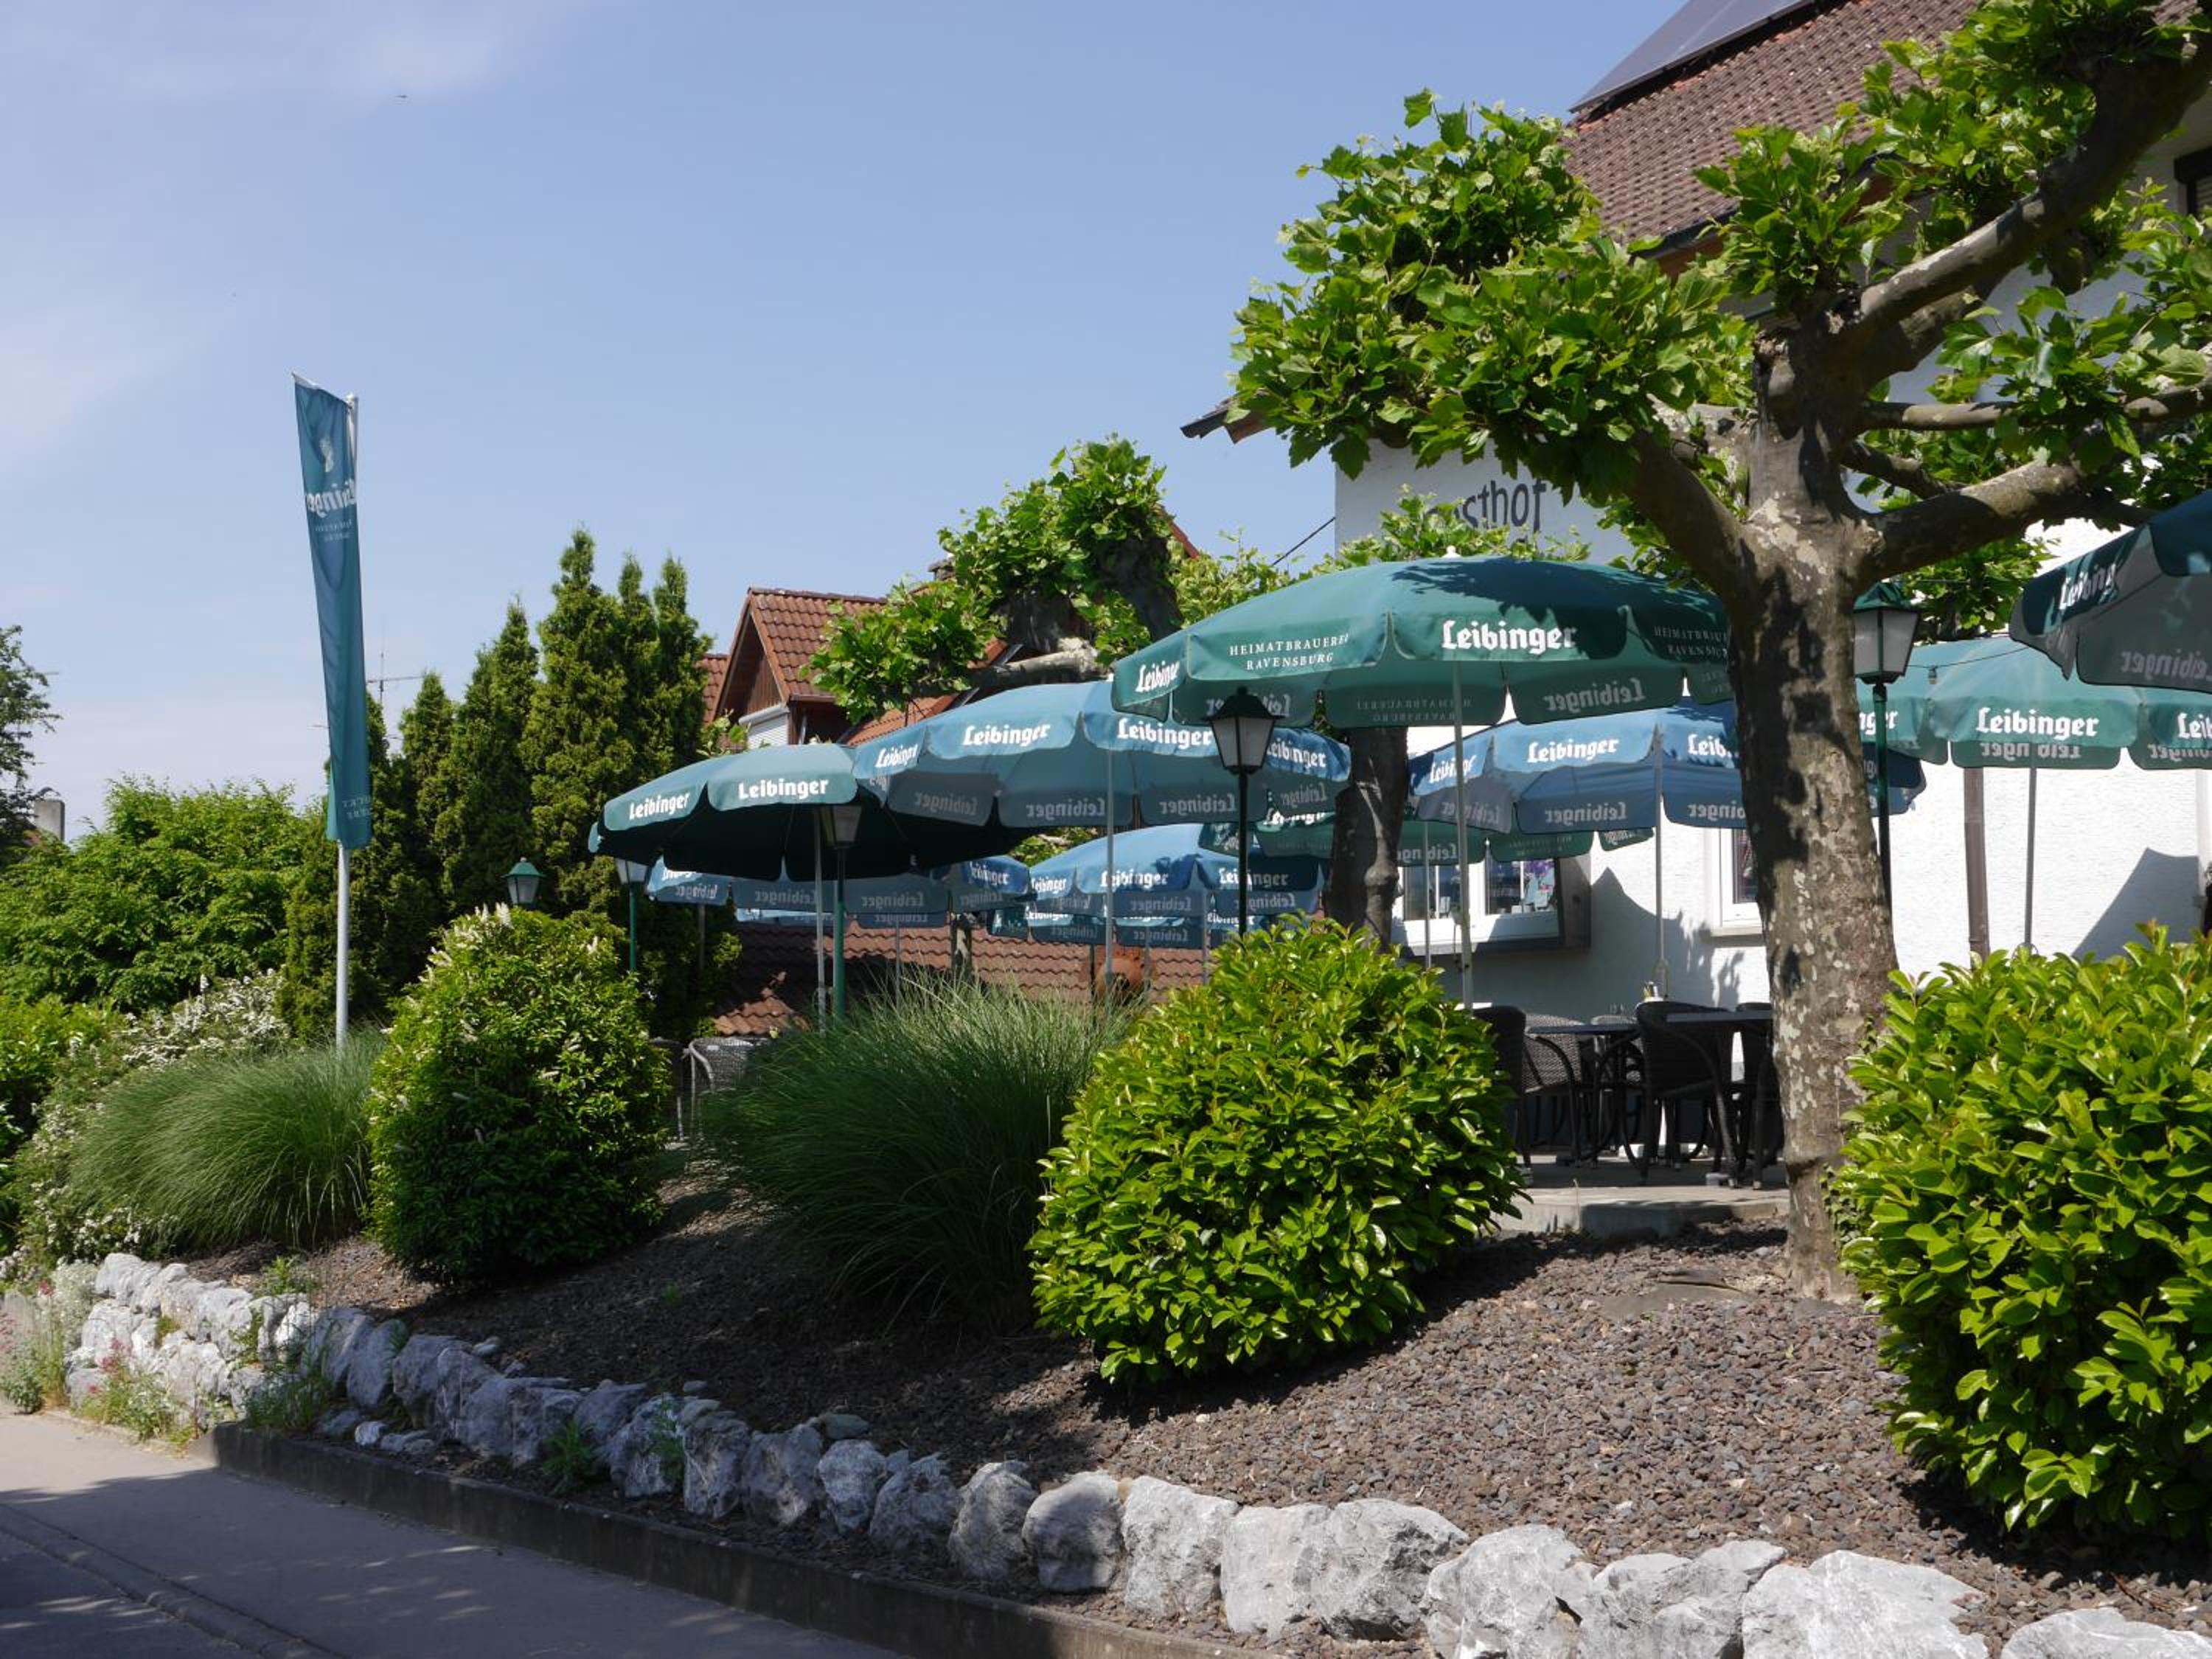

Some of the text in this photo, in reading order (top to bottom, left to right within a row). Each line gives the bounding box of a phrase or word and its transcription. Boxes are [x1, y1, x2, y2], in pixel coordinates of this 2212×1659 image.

[1228, 633, 1349, 656] HEIMATBRAUEREI
[1441, 619, 1578, 655] Leibinger
[1246, 652, 1334, 670] RAVENSBURG
[963, 723, 1051, 746] Leibinger
[1116, 717, 1214, 748] Leibinger
[1976, 707, 2100, 741] Leibinger
[1527, 738, 1619, 763] Leibinger
[738, 778, 829, 799] Leibinger
[629, 792, 691, 820] Leibinger
